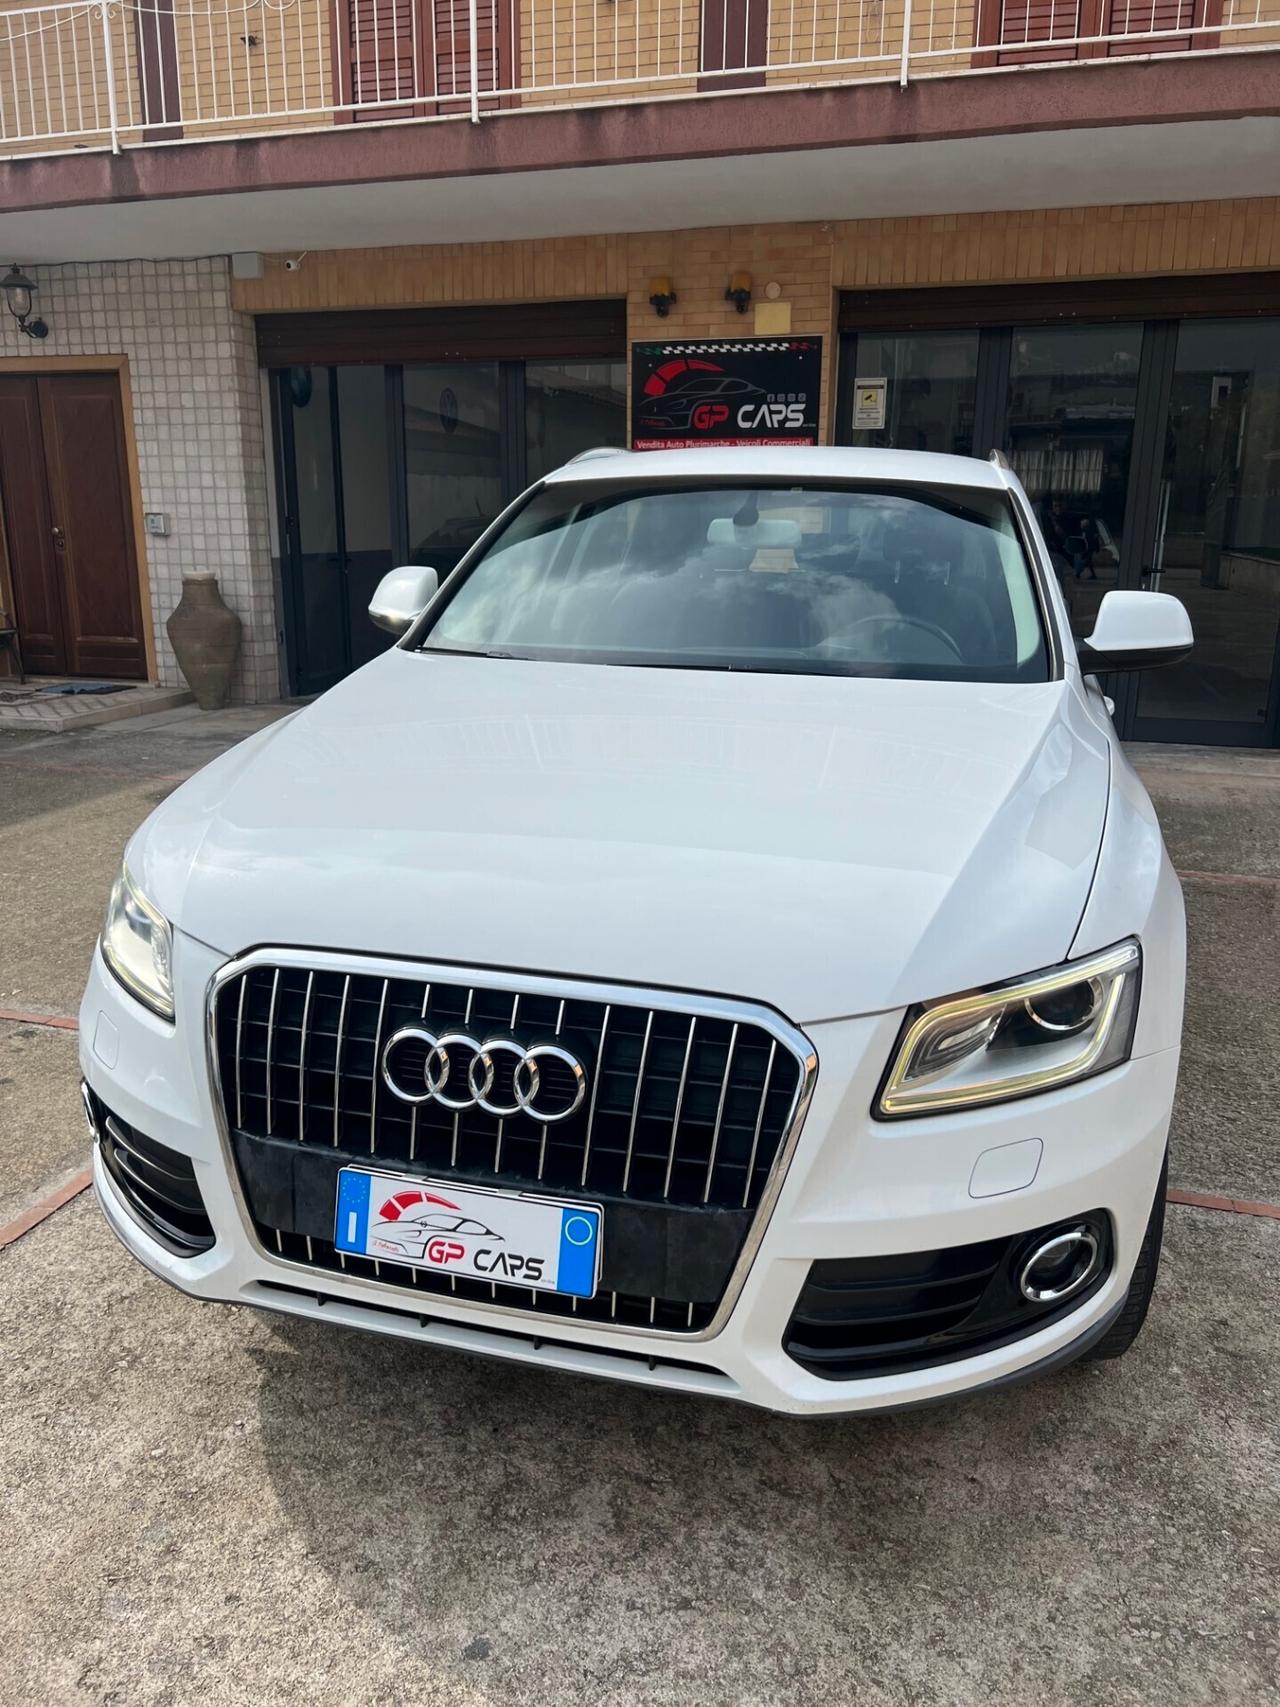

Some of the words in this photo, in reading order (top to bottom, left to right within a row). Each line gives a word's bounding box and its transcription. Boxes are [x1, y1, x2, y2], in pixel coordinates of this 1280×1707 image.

[694, 405, 729, 429] GP
[637, 440, 665, 449] Vendita
[666, 440, 684, 448] Auto
[685, 440, 730, 448] Plurimarche
[736, 439, 761, 447] Veicoli
[762, 438, 811, 447] Commerciali
[429, 1240, 465, 1264] GP
